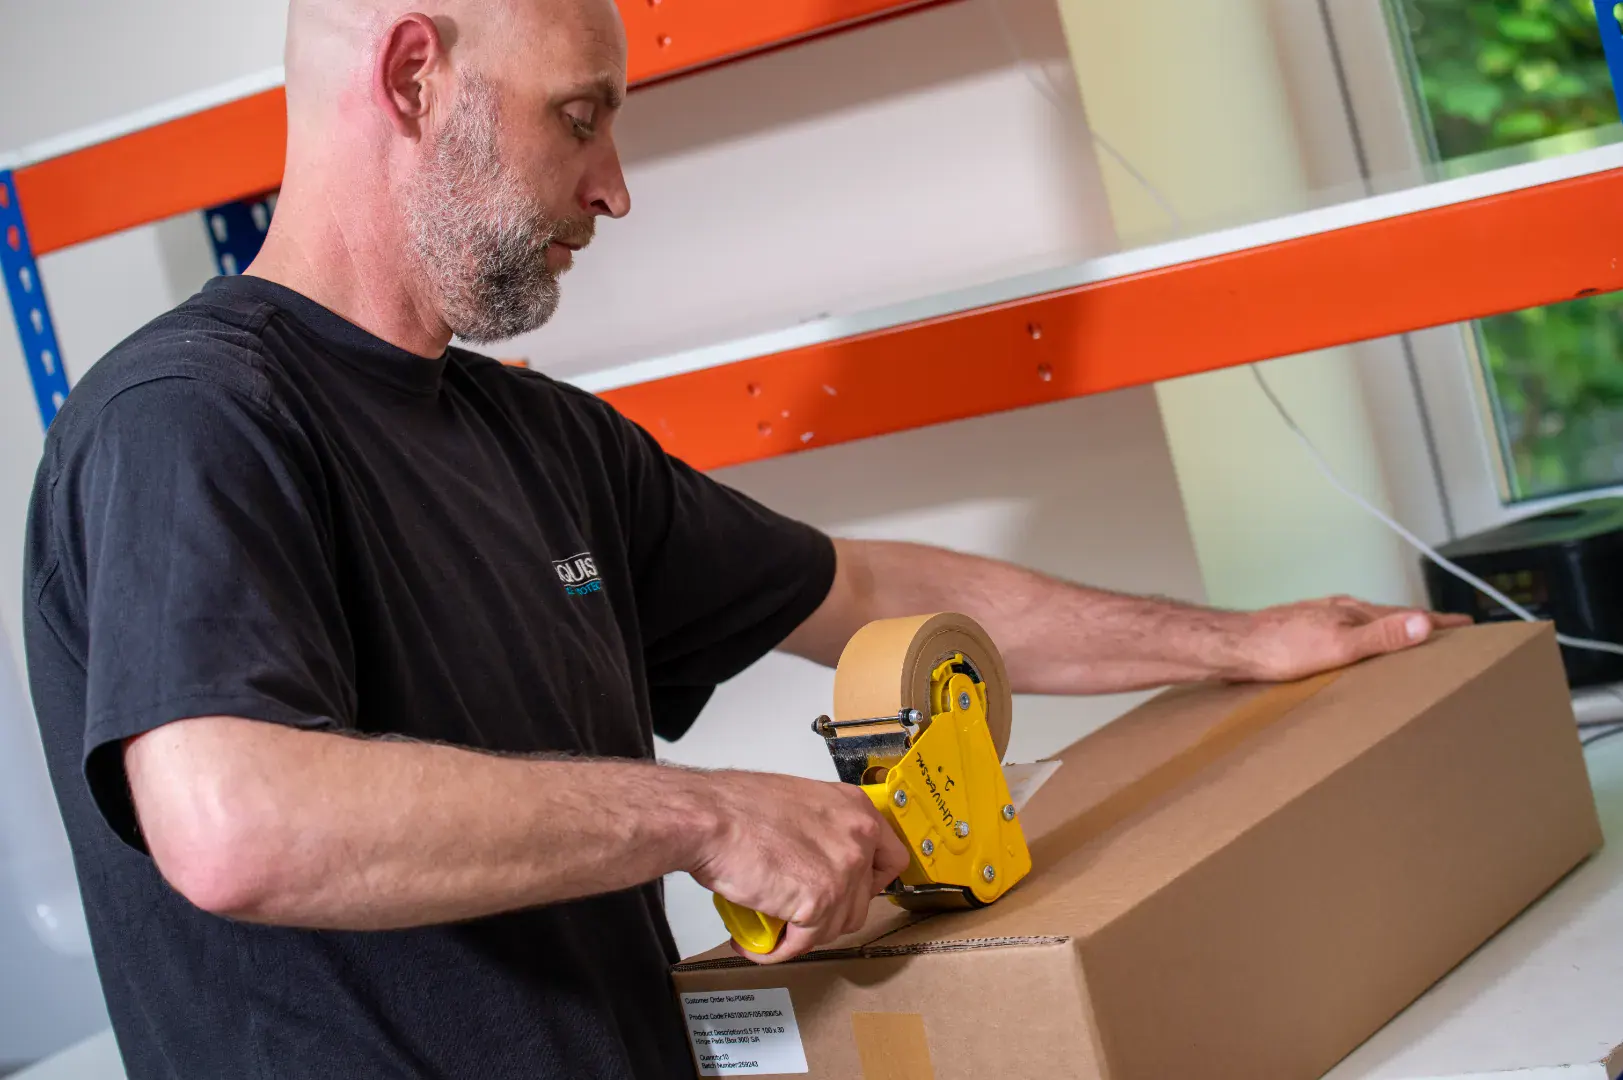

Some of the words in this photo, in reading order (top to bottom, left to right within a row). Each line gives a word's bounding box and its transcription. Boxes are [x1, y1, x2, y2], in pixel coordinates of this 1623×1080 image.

[555, 557, 599, 583] QUIS
[685, 997, 709, 1005] Customer
[710, 996, 725, 1004] Order
[777, 1026, 785, 1034] 30
[711, 1037, 724, 1045] Pads
